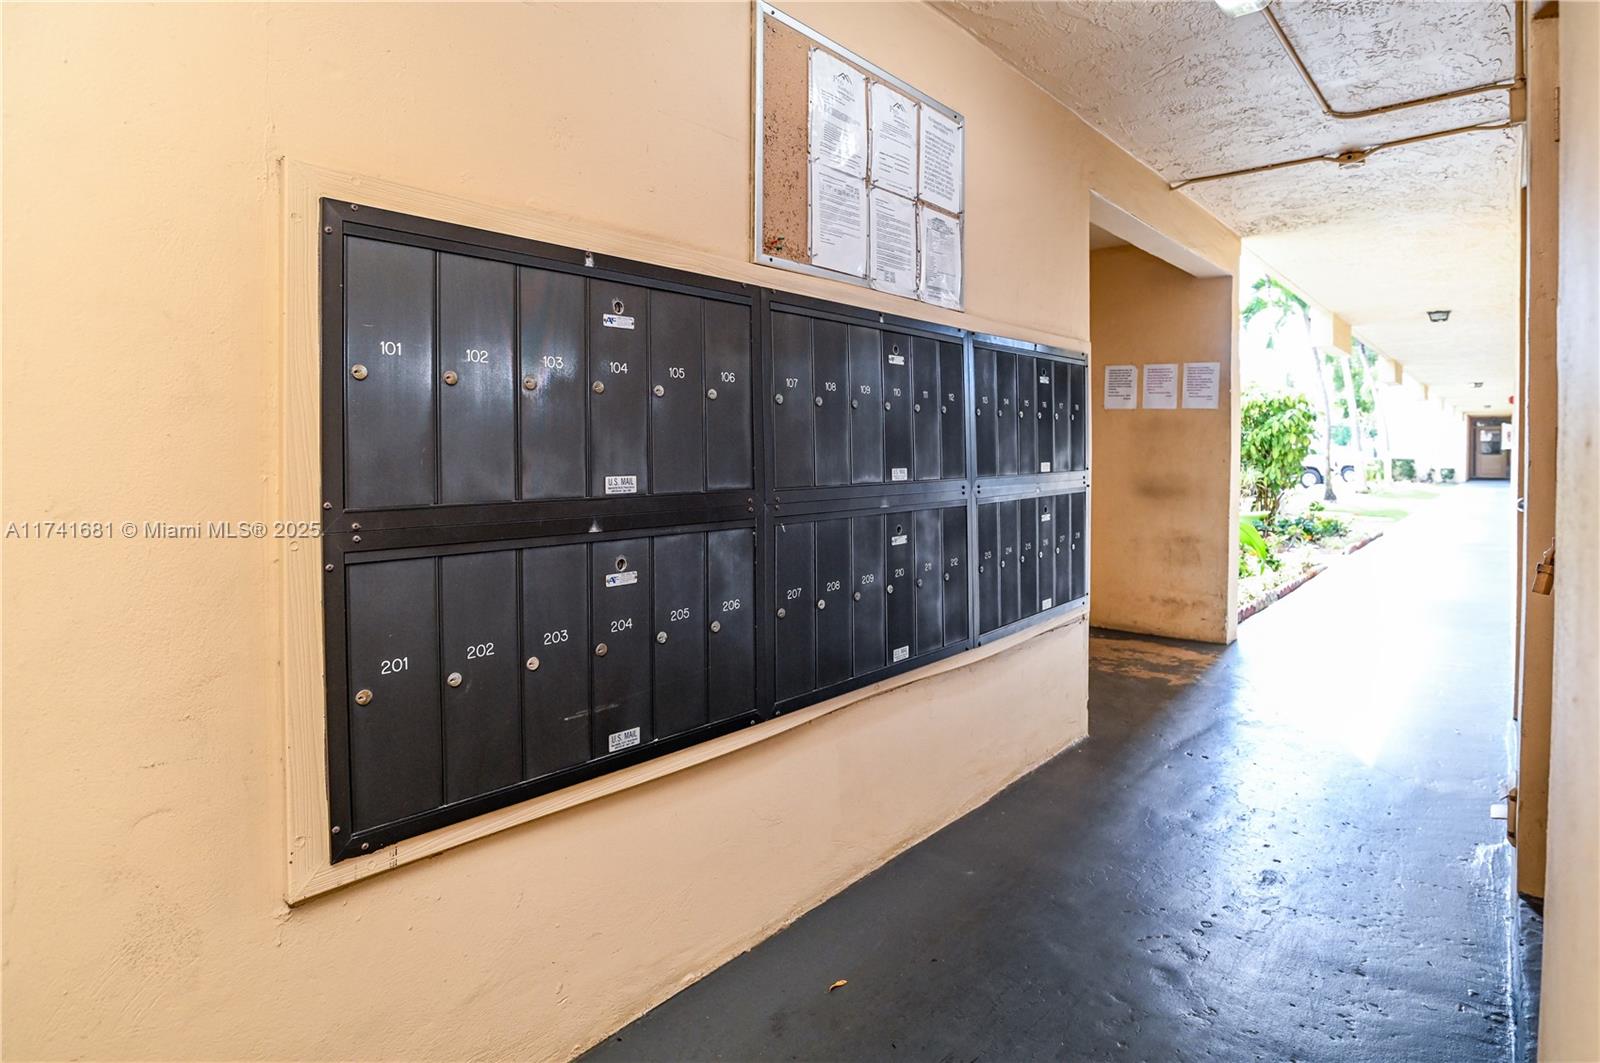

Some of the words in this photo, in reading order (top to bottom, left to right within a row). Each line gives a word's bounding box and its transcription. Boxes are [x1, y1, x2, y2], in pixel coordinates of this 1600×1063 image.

[380, 341, 402, 356] 101
[465, 349, 489, 364] 102
[543, 356, 564, 369] 103
[609, 362, 628, 374] 104
[668, 367, 685, 379] 105
[720, 371, 735, 383] 106
[785, 378, 799, 388] 107
[825, 382, 837, 392] 108
[860, 385, 871, 394] 109
[893, 388, 902, 397] 110
[620, 477, 635, 486] MAIL
[894, 567, 905, 578] 210
[861, 573, 875, 585] 209
[826, 580, 841, 592] 208
[787, 587, 802, 600] 207
[722, 598, 741, 612] 206
[670, 607, 690, 622] 205
[610, 618, 633, 633] 204
[543, 629, 569, 646] 203
[466, 642, 495, 660] 202
[381, 657, 409, 675] 201
